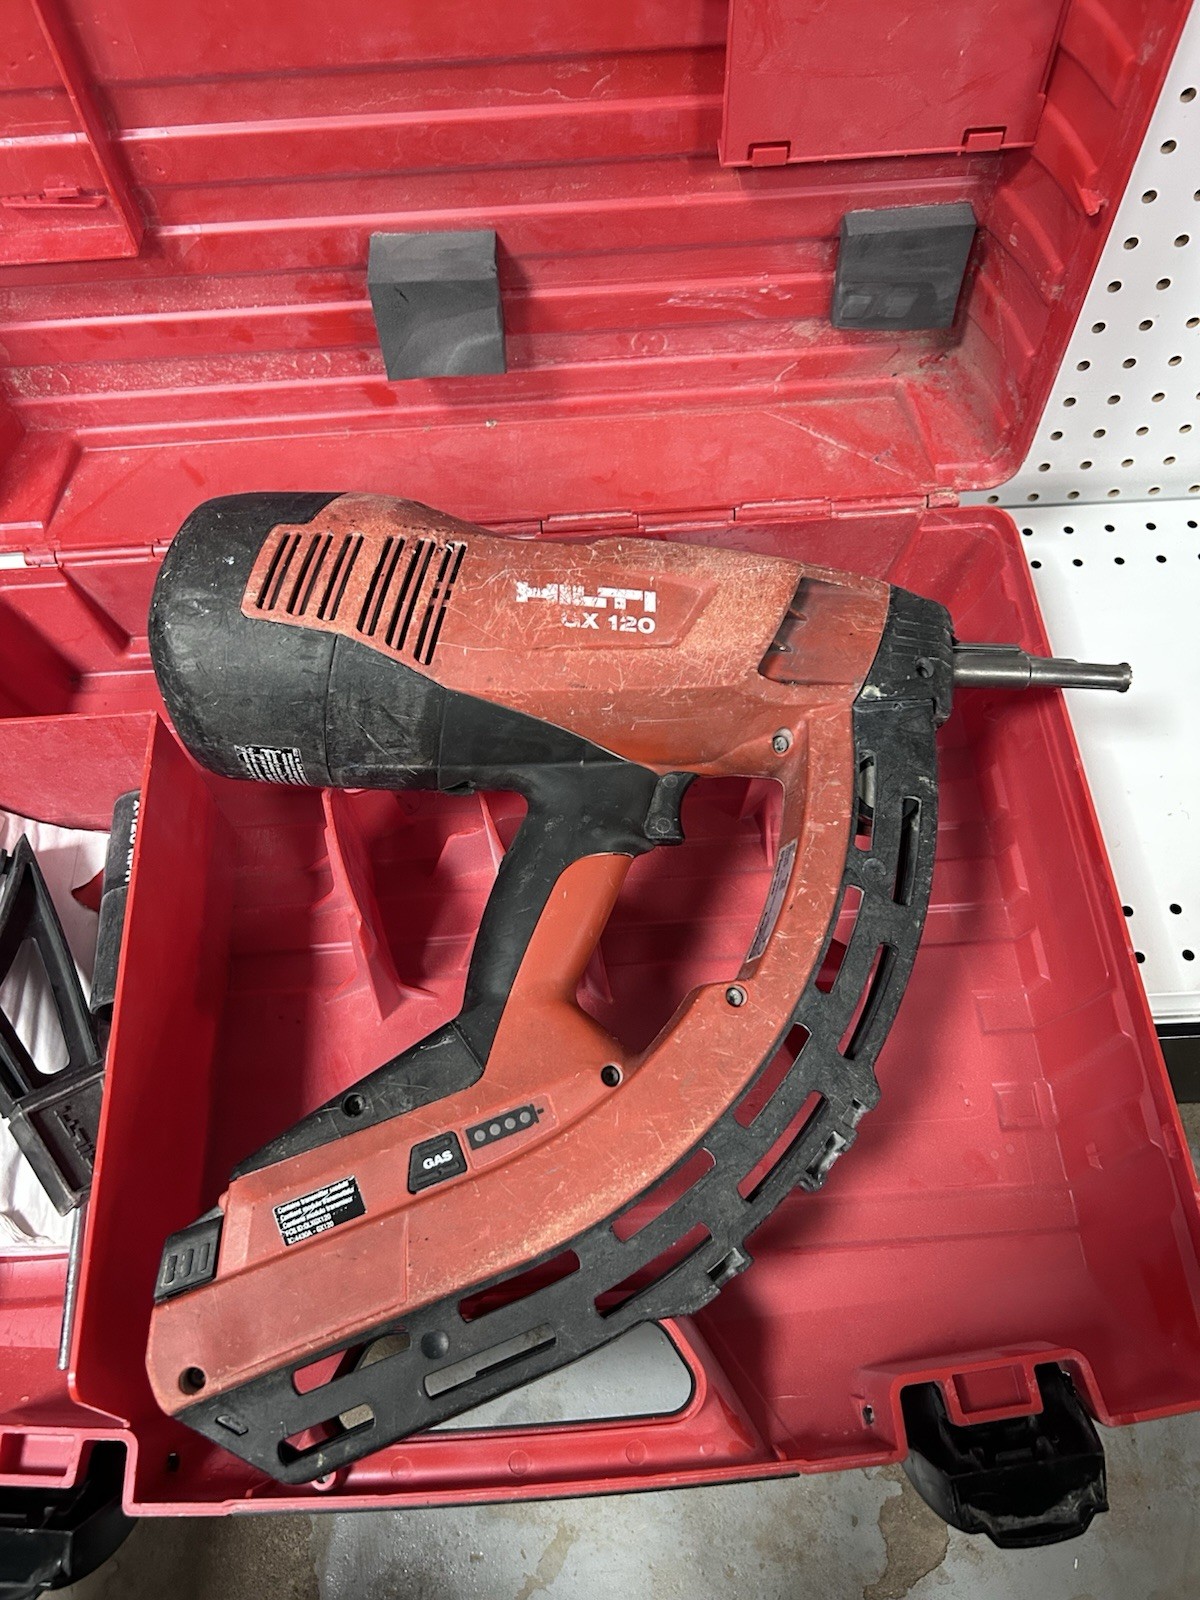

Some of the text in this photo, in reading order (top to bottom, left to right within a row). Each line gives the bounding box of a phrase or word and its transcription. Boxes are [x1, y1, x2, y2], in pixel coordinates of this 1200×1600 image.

[516, 581, 657, 613] HILTI
[607, 614, 656, 635] 120
[422, 1149, 454, 1170] GAS
